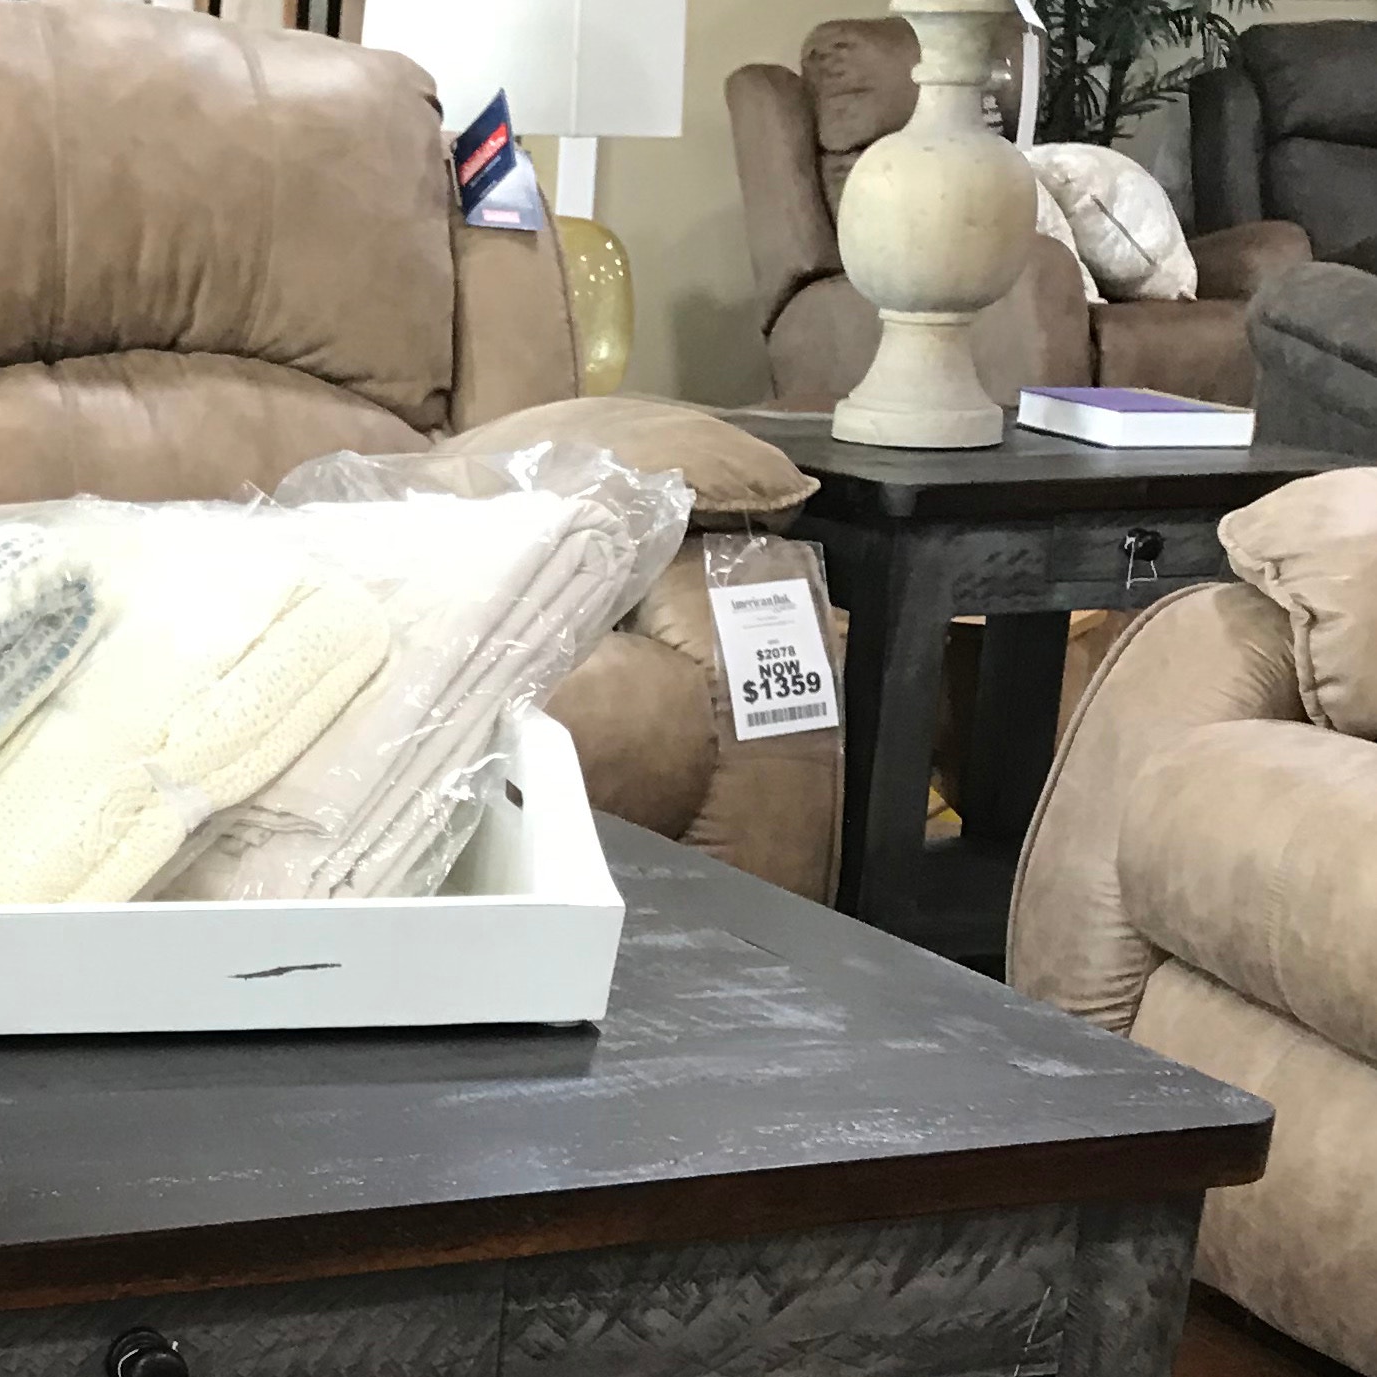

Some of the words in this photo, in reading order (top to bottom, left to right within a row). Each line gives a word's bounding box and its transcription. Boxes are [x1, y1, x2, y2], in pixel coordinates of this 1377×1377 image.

[756, 645, 796, 661] $2078
[759, 660, 800, 679] NOW
[742, 672, 821, 705] $1359
